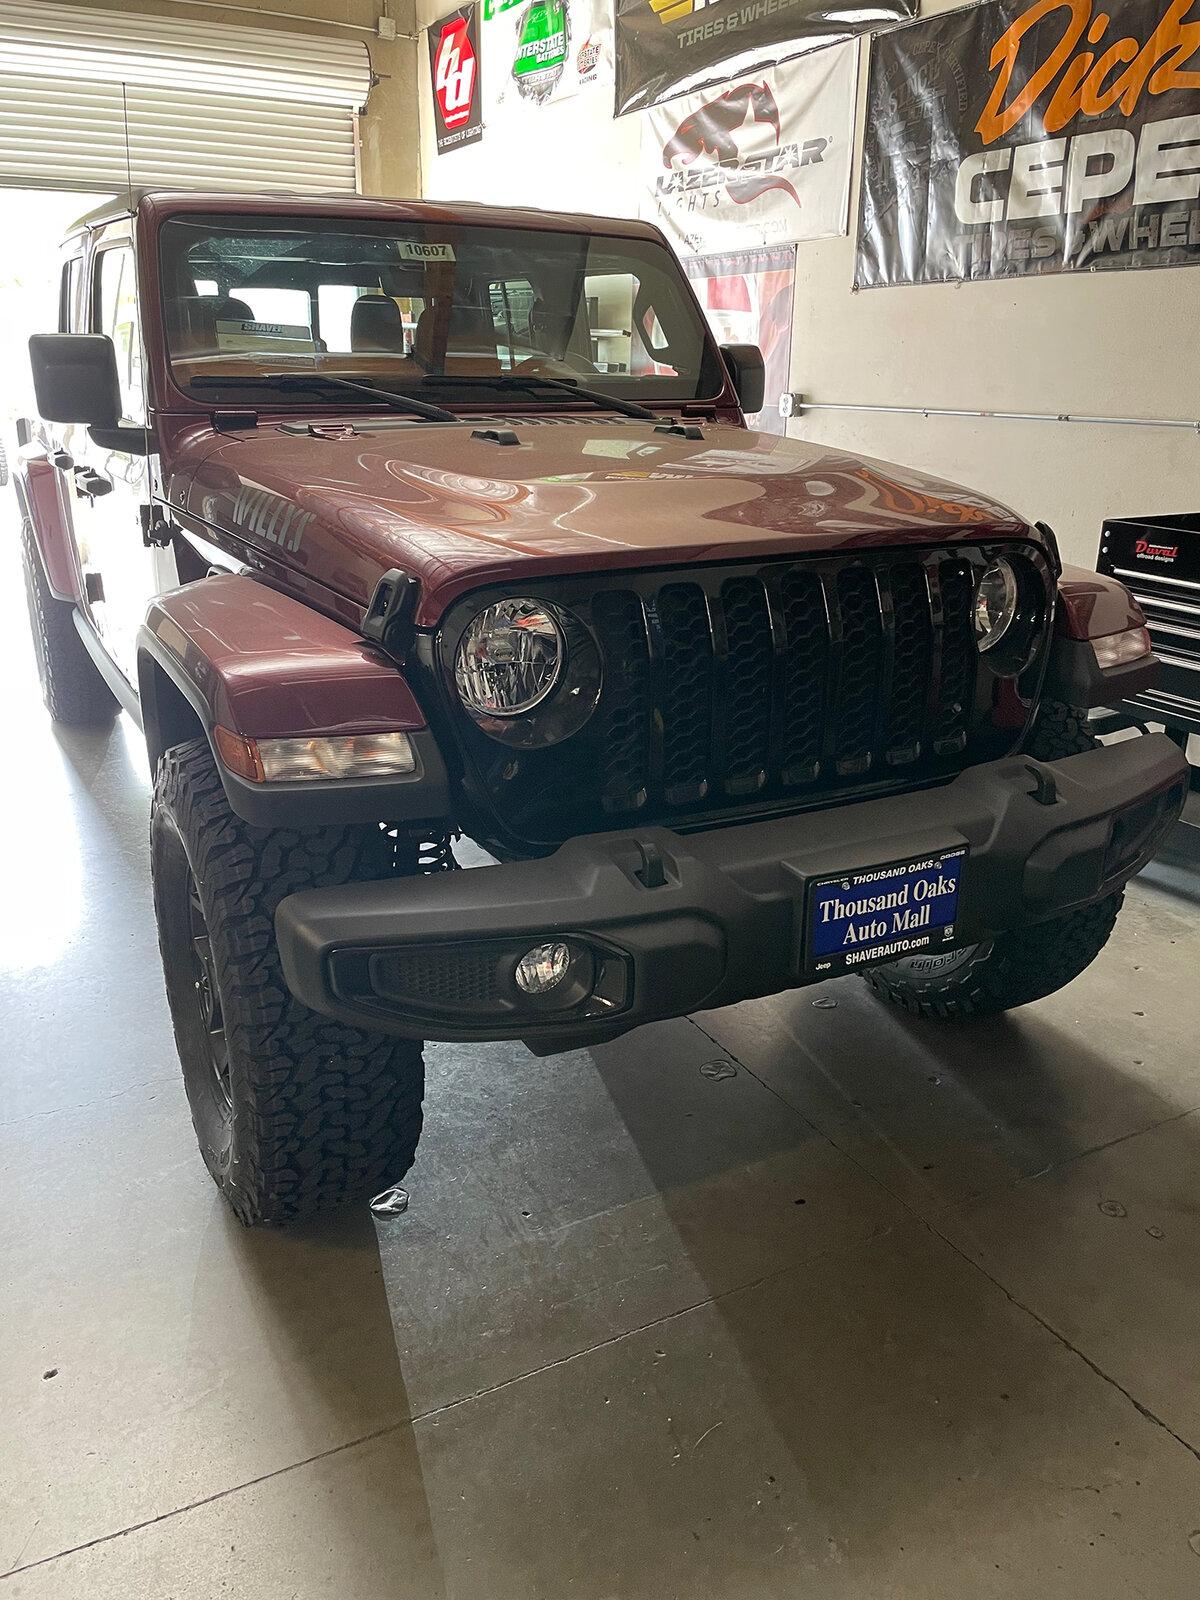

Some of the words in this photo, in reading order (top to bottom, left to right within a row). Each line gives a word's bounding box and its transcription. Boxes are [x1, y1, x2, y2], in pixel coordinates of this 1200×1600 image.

[677, 18, 724, 48] TIRES
[726, 12, 739, 30] &
[516, 32, 564, 60] NTERSTATE
[406, 244, 446, 256] 10607
[1135, 540, 1178, 557] Duval
[940, 850, 966, 860] DODGE
[853, 866, 907, 885] THOUSAND
[908, 859, 934, 874] OAKS
[819, 884, 908, 923] Thousand
[913, 875, 956, 901] Oaks
[842, 919, 887, 945] Auto
[891, 904, 931, 934] Mall
[845, 935, 930, 965] SHAVERAUTO.com
[815, 961, 831, 971] Jeep
